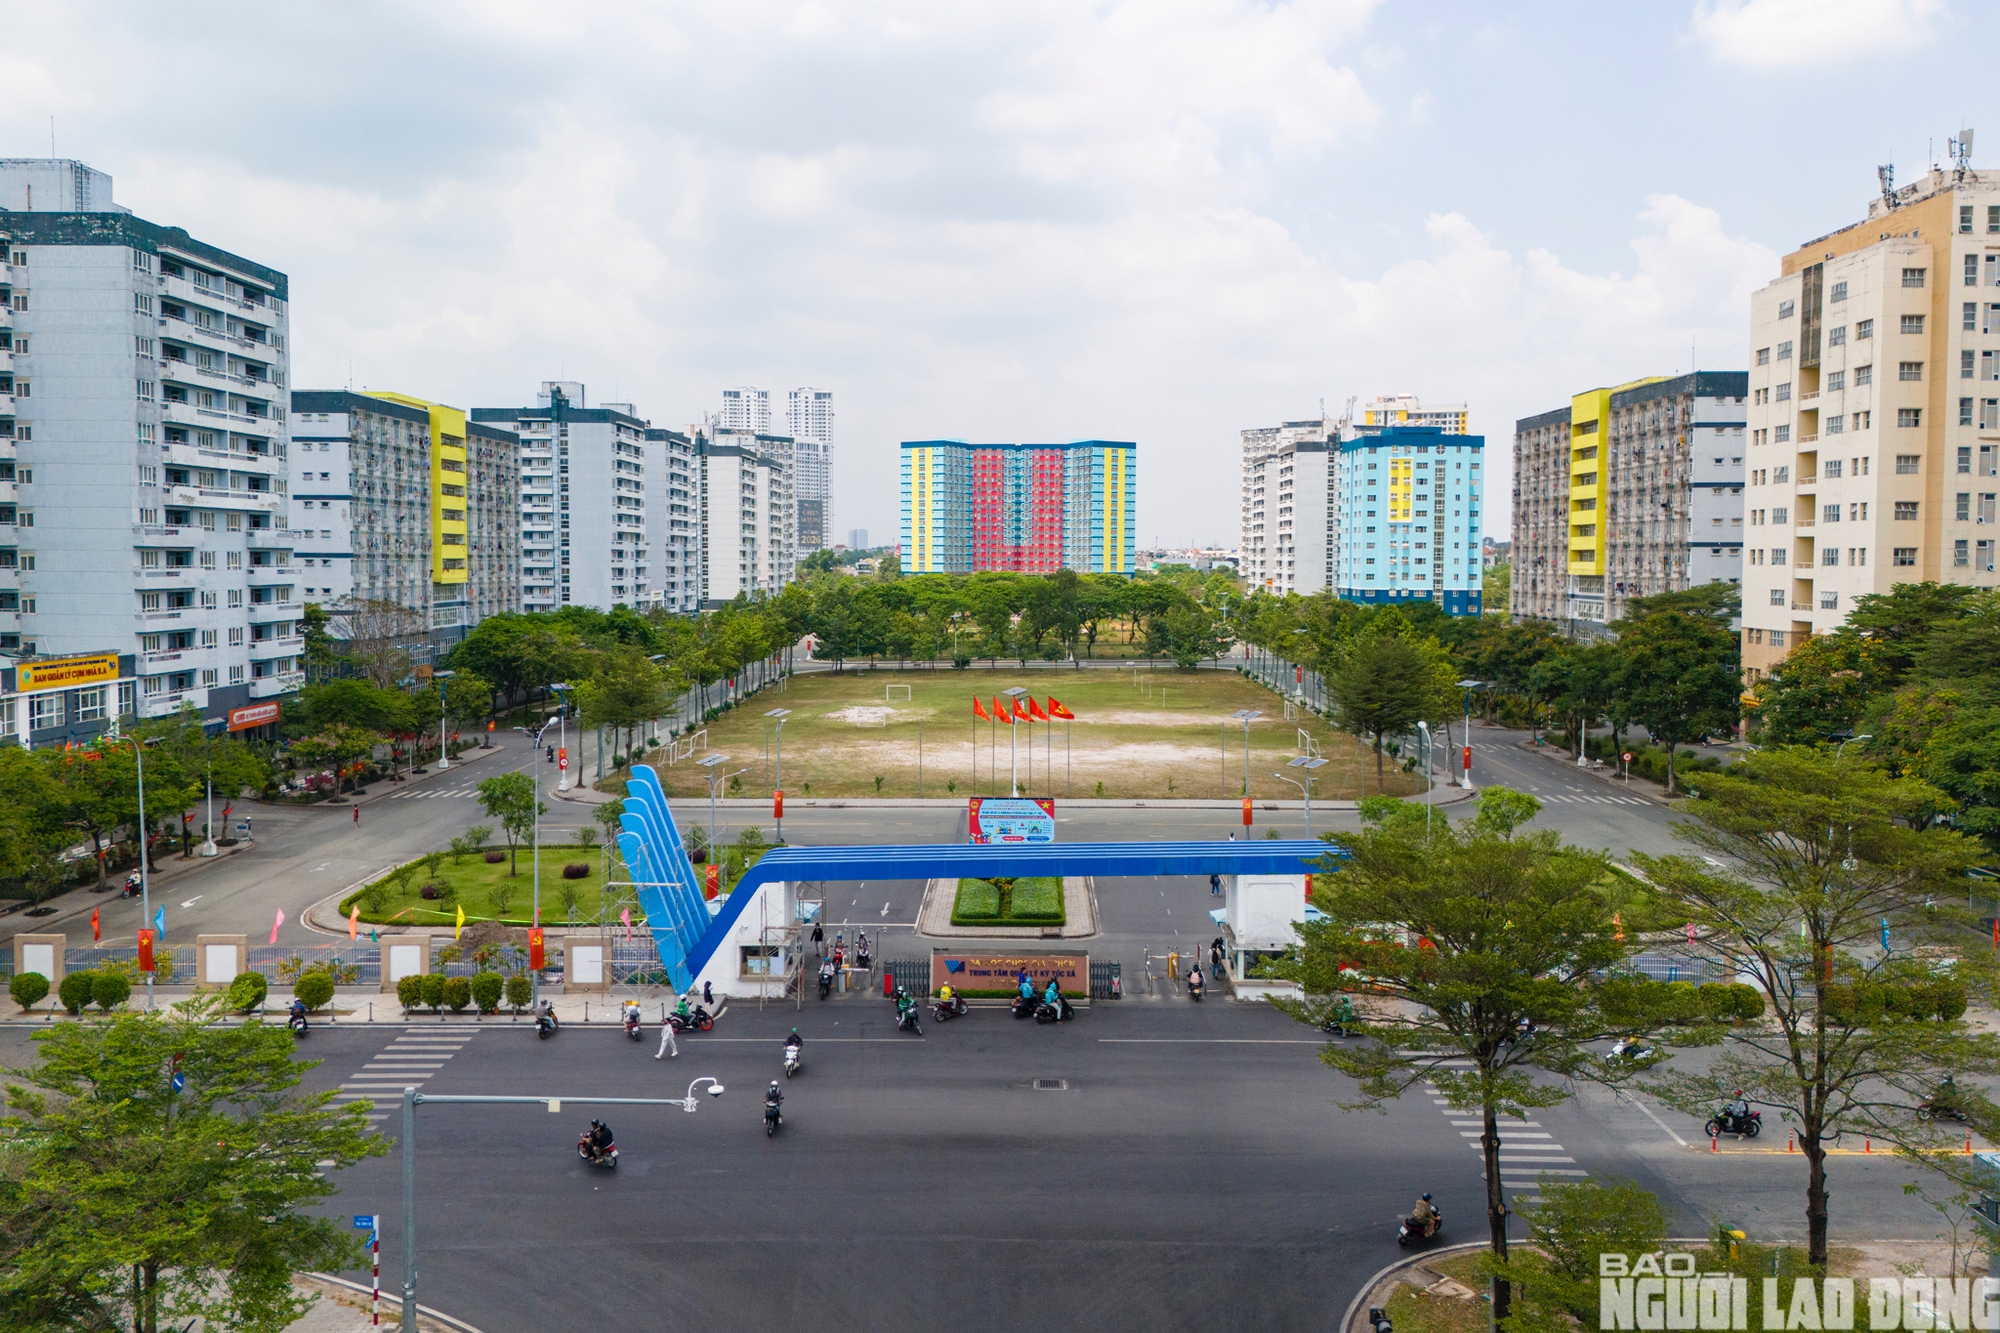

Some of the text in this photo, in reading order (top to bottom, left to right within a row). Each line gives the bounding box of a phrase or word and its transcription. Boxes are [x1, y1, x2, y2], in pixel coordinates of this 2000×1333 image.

[801, 536, 821, 544] 2026
[34, 674, 46, 683] BAN
[48, 670, 64, 681] QUẢN
[64, 669, 72, 679] LÝ
[72, 670, 84, 680] CỤM
[86, 666, 97, 676] NHÀ
[969, 969, 991, 977] TRUNG
